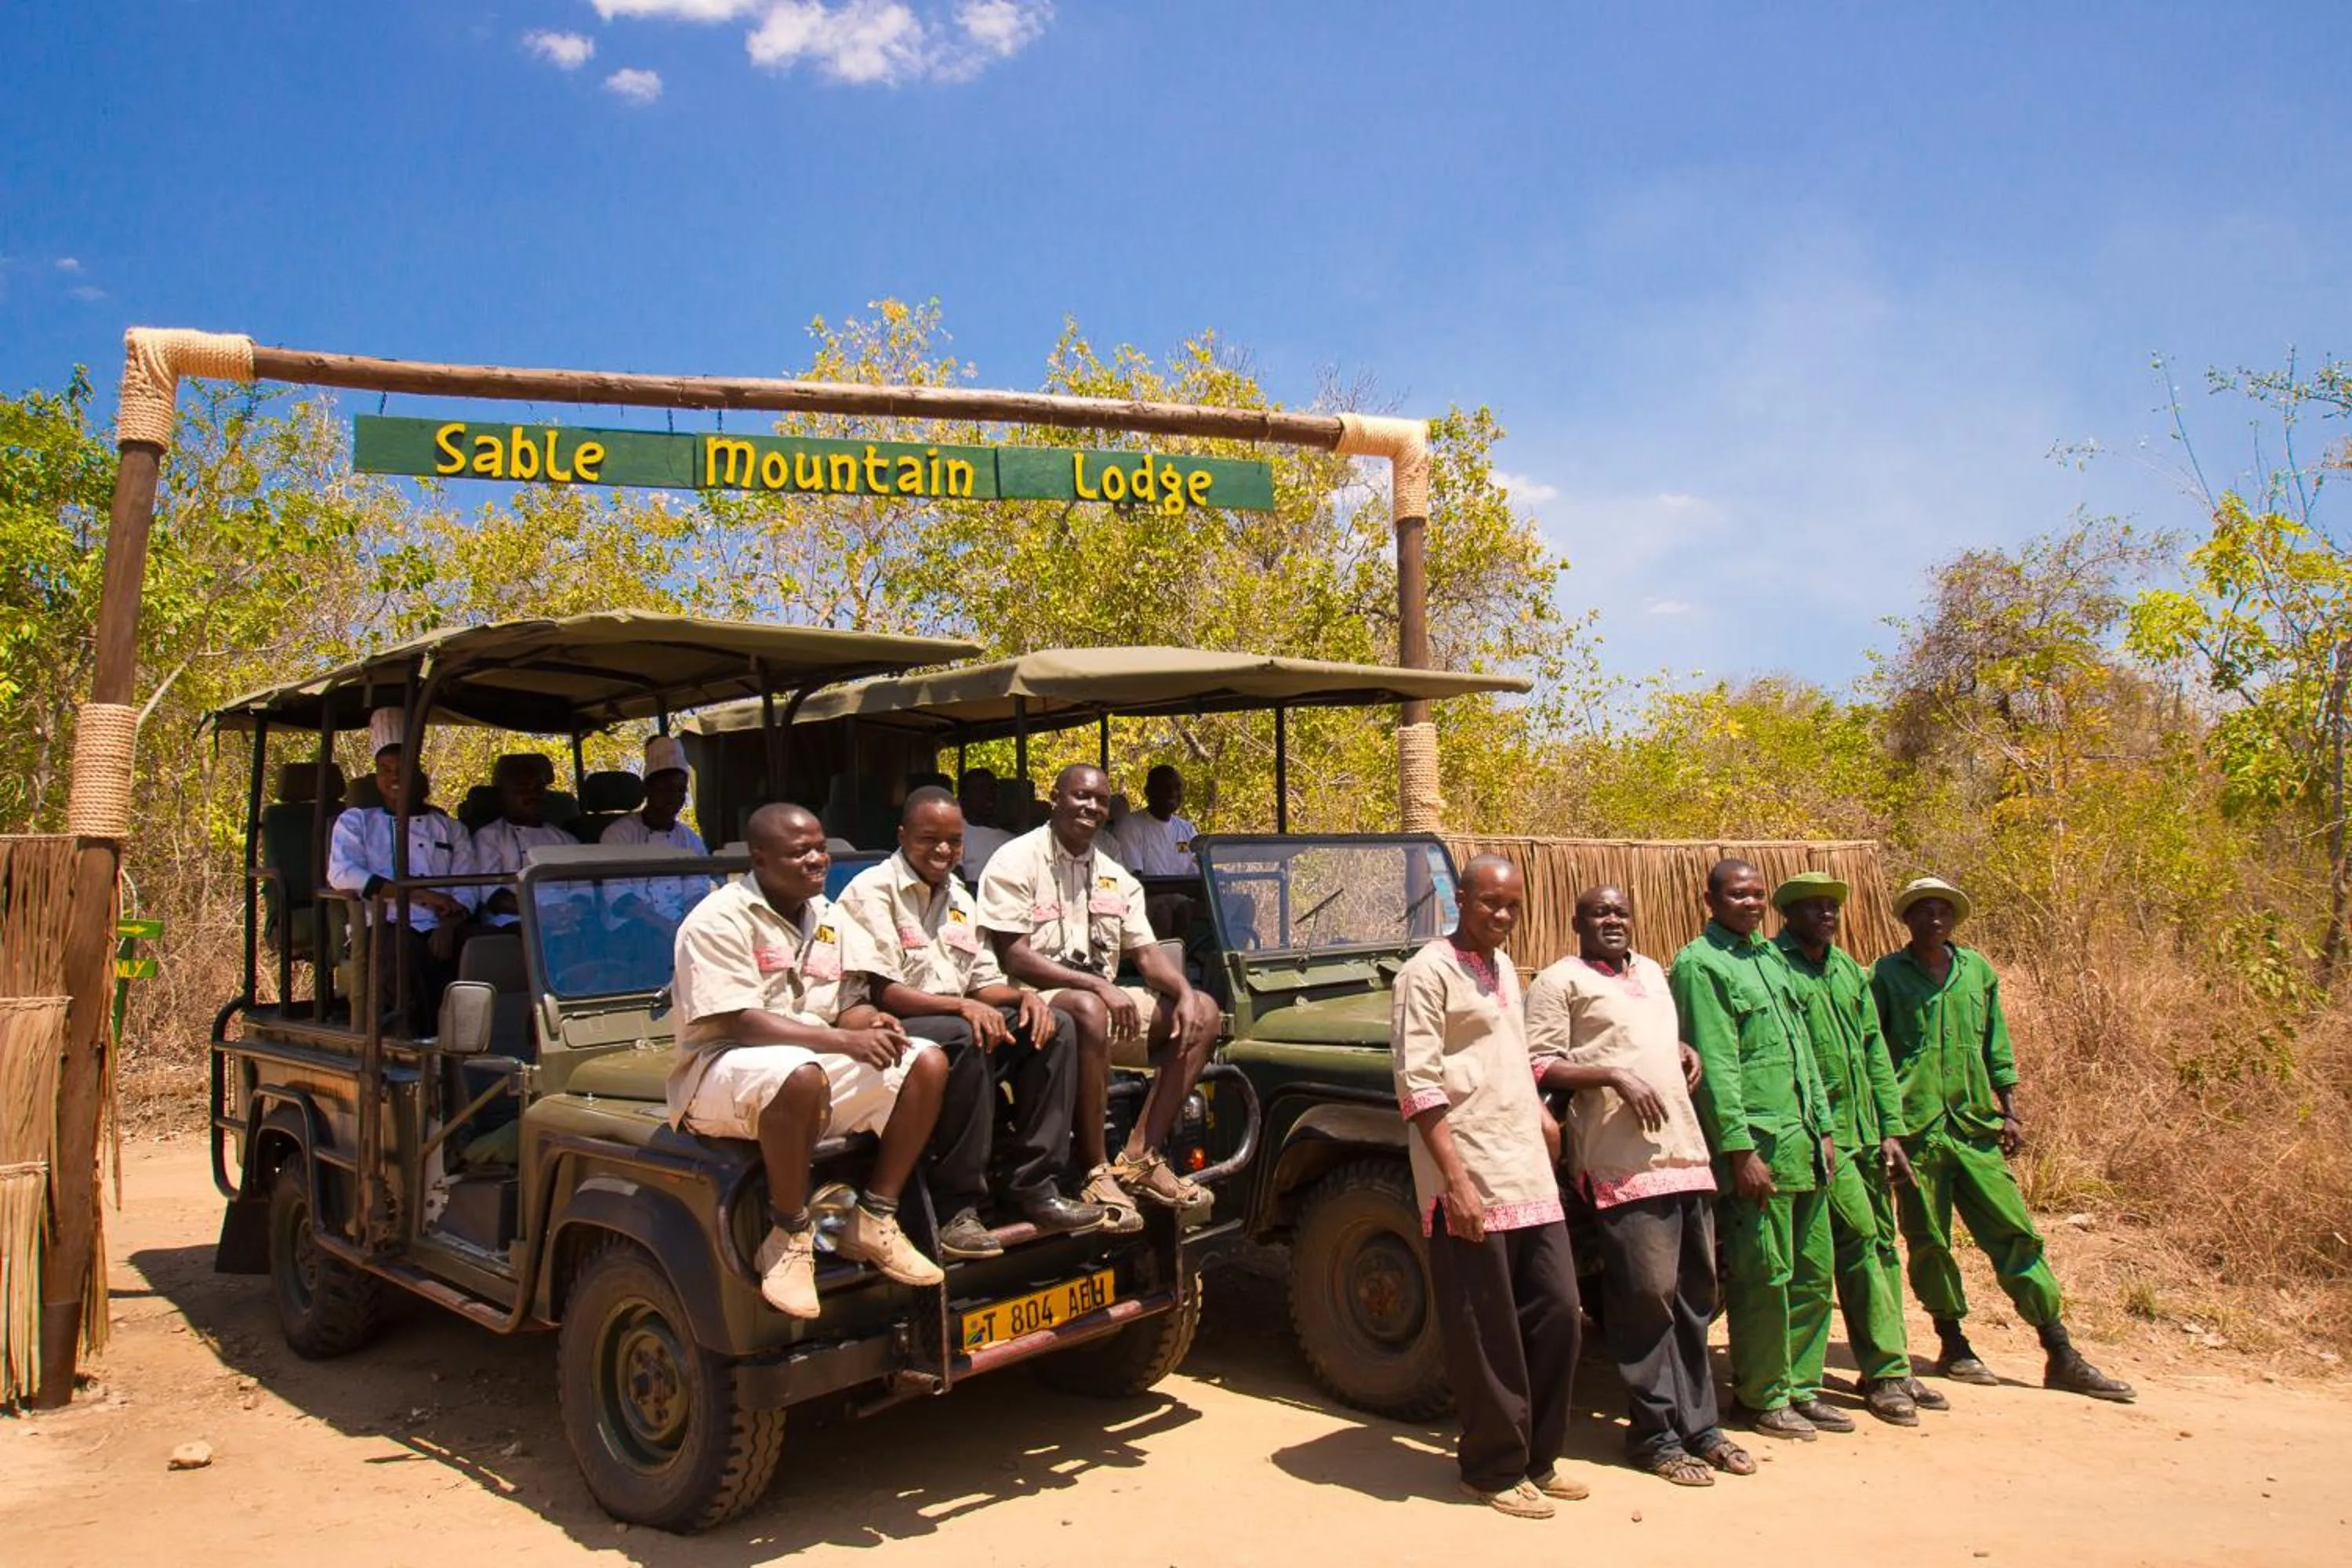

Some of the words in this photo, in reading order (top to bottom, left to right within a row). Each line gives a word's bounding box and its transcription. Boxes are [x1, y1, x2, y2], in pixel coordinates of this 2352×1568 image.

[435, 423, 605, 482] Sable
[706, 436, 975, 499] Mountain
[1073, 450, 1213, 517] Lodge
[115, 959, 147, 978] NLY
[982, 1311, 996, 1342] T
[1011, 1293, 1053, 1334] 804
